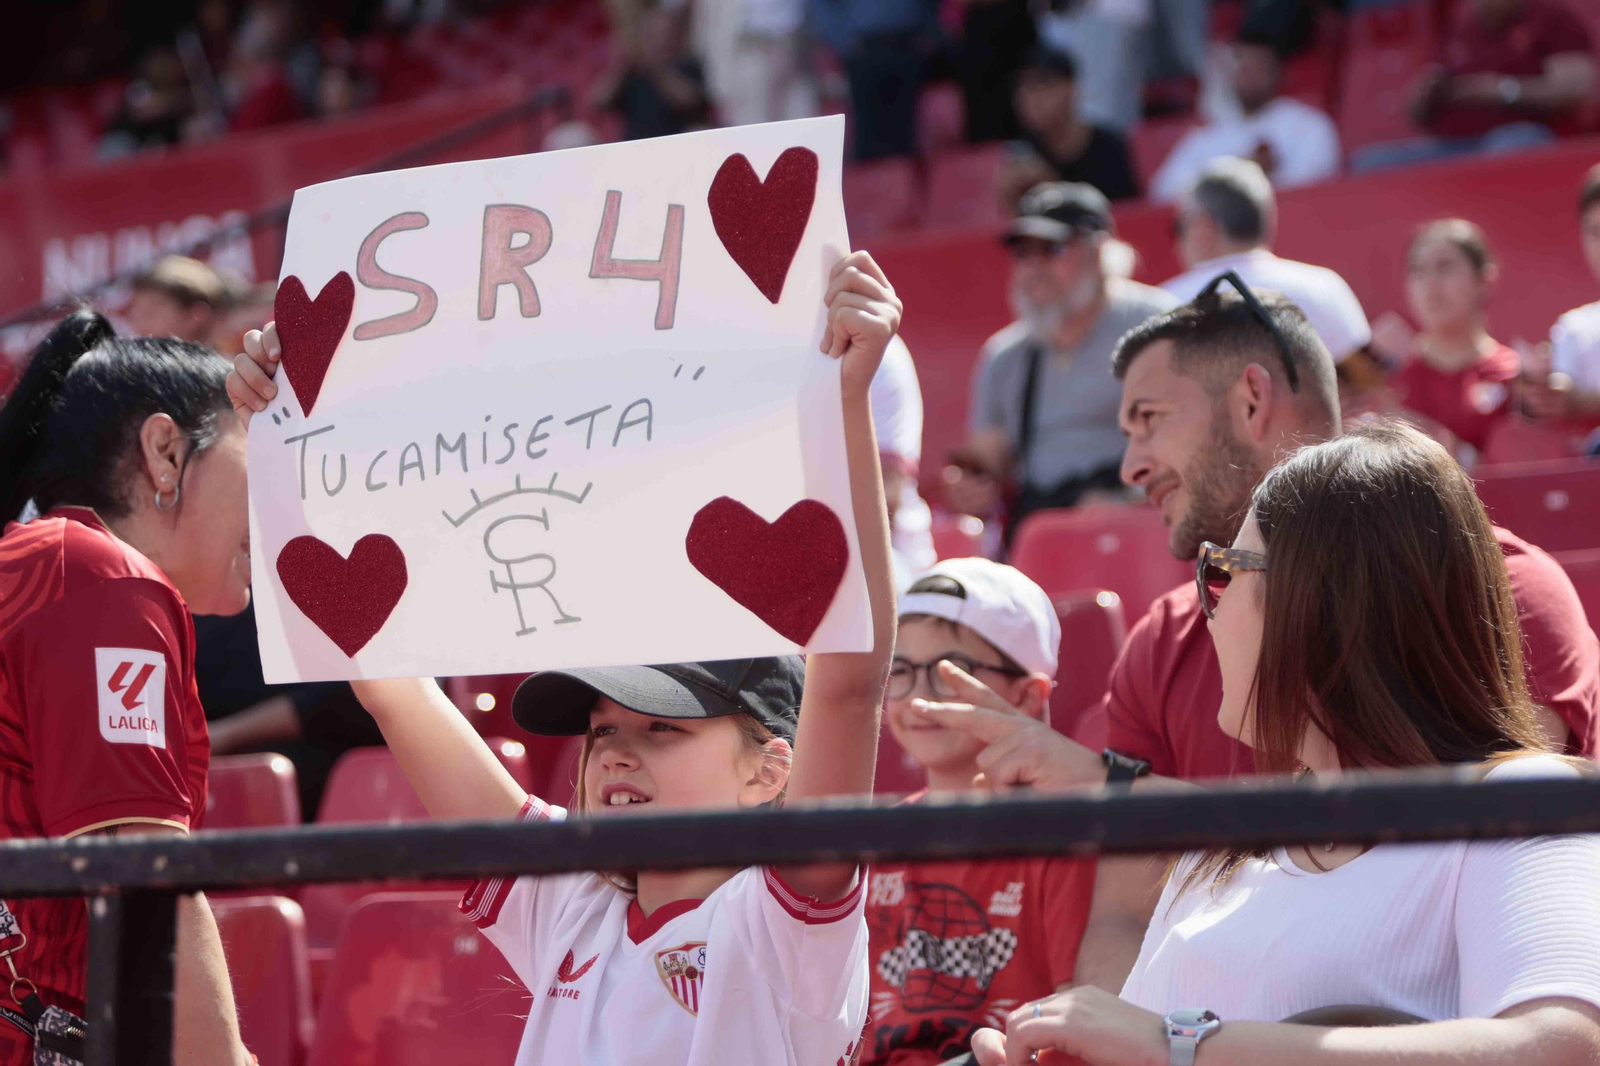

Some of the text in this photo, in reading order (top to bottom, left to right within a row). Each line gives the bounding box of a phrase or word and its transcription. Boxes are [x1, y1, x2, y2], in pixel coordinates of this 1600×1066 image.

[353, 189, 685, 342] SR4
[108, 715, 159, 734] LALIGA
[547, 986, 581, 1000] ATORE
